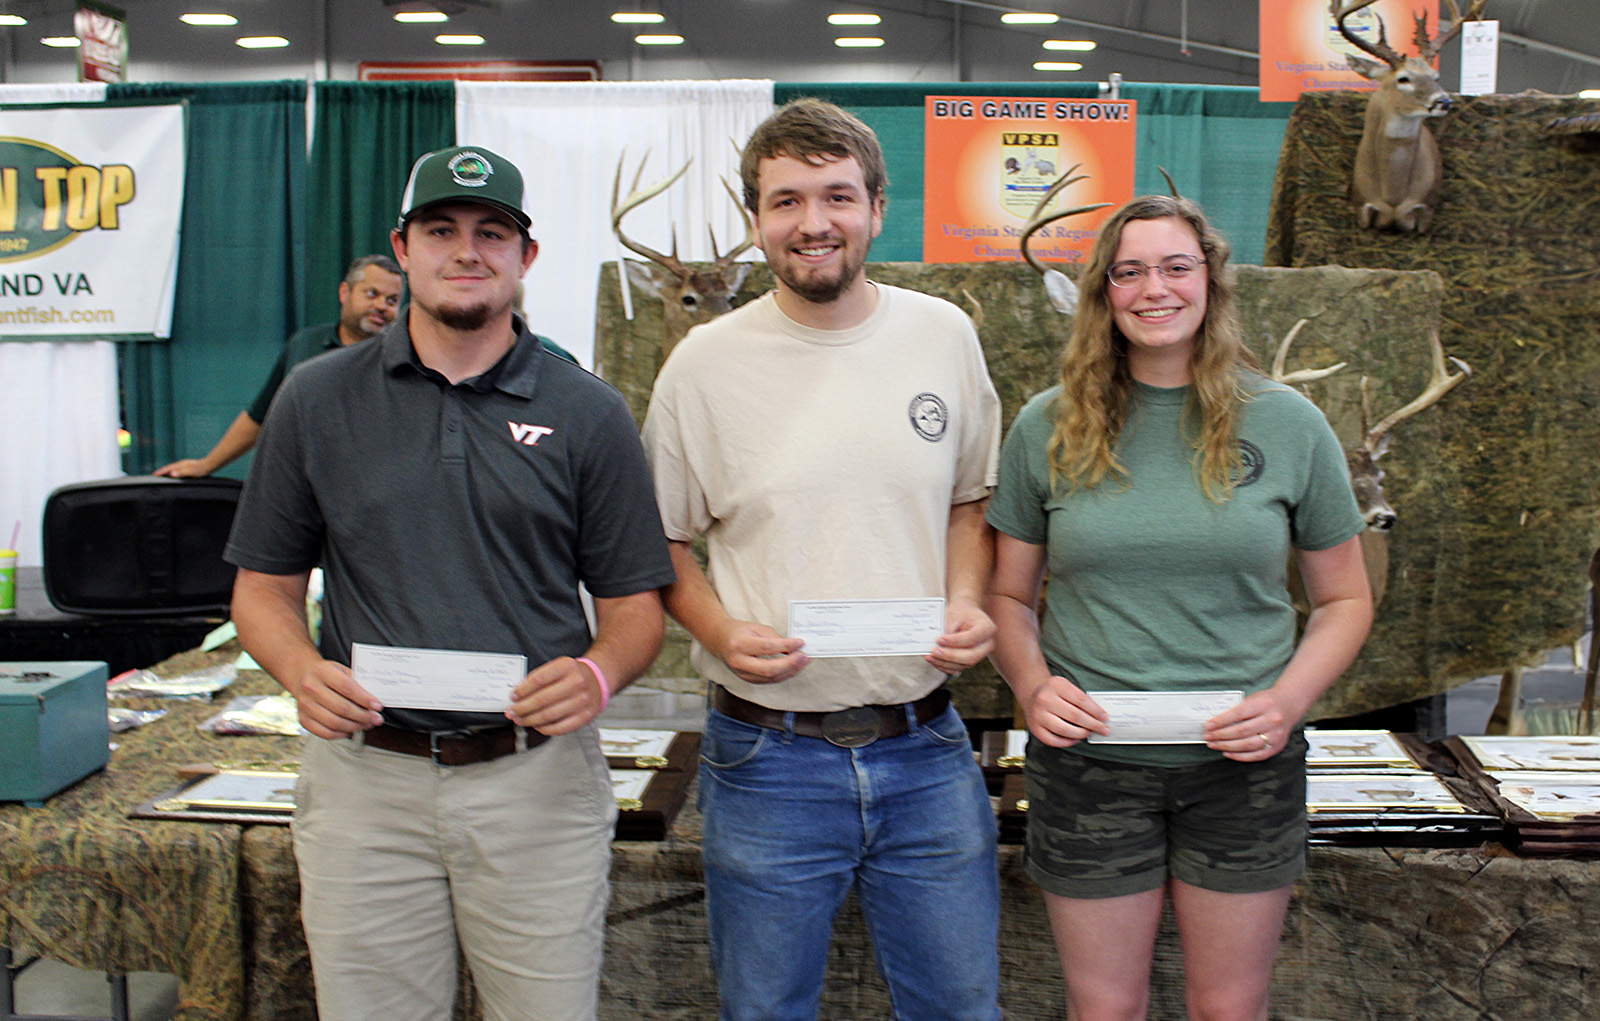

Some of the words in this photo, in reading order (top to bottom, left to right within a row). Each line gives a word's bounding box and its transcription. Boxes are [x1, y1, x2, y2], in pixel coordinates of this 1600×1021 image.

[1275, 61, 1324, 74] Virginia
[934, 101, 974, 118] BIG
[981, 102, 1047, 119] GAME
[1054, 103, 1130, 120] SHOW!
[1004, 133, 1057, 146] VPSA
[36, 164, 135, 232] TOP
[942, 224, 998, 240] Virginia
[0, 273, 43, 296] ND
[52, 272, 94, 296] VA
[507, 420, 555, 446] VT
